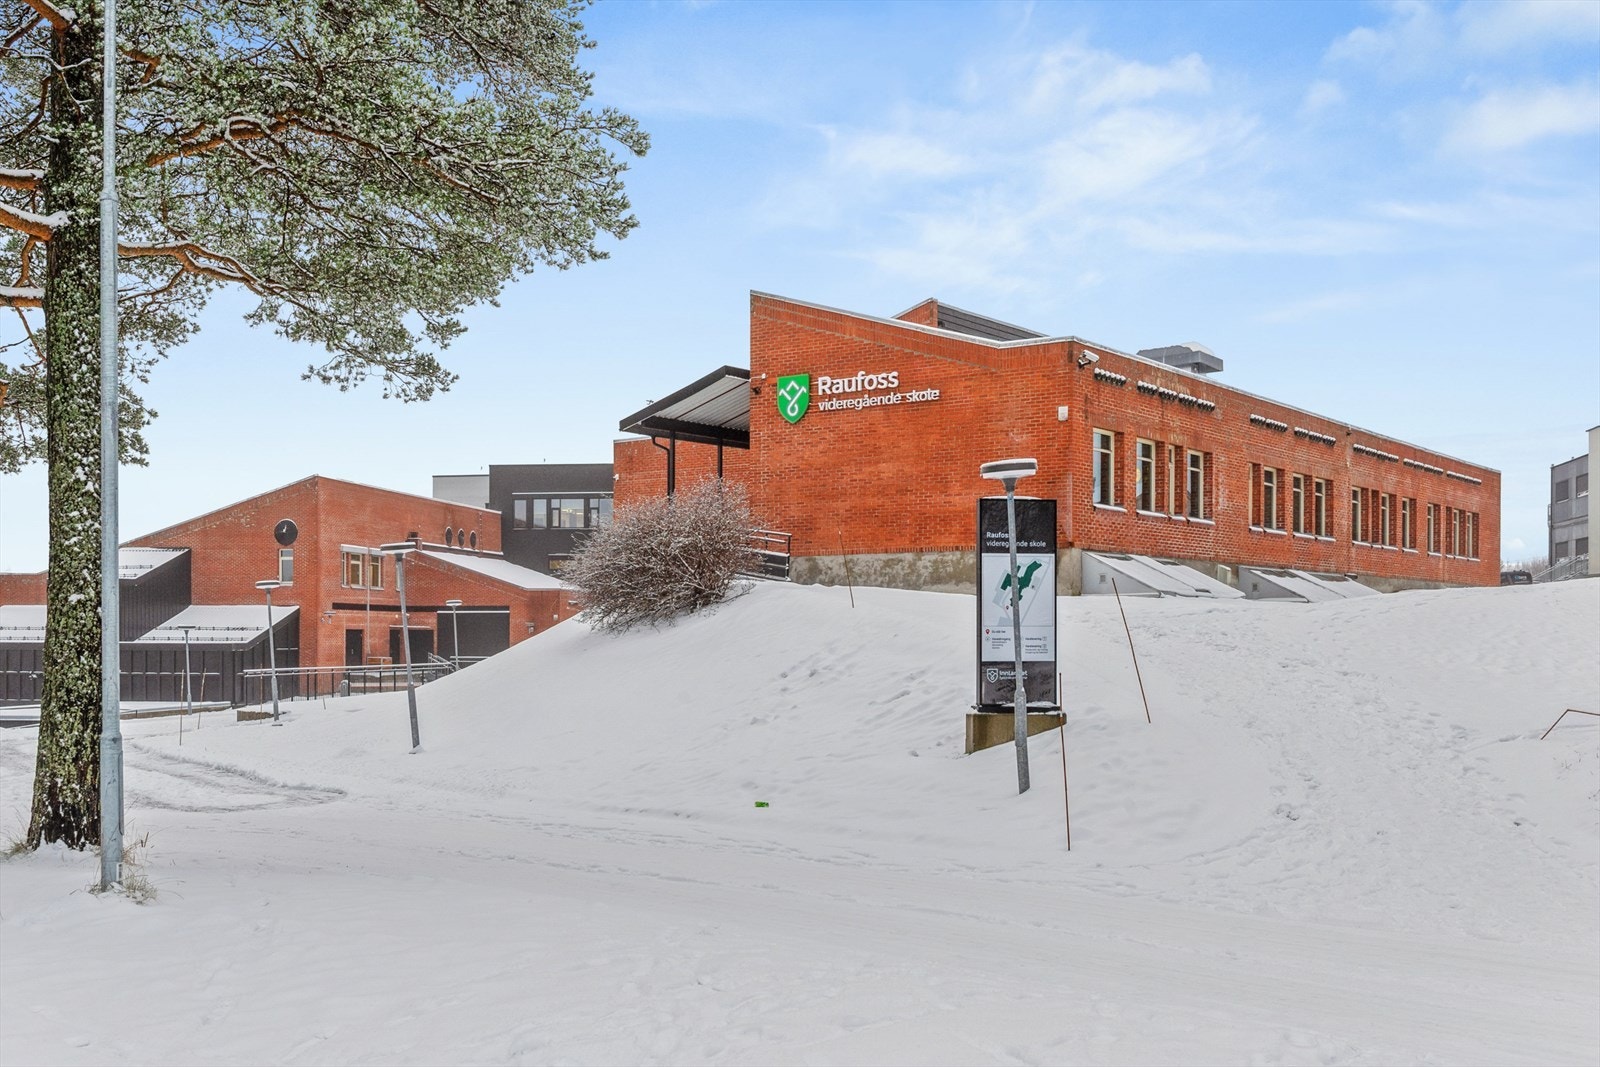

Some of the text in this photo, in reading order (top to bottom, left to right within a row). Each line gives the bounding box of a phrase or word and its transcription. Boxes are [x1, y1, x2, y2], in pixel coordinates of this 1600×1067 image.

[817, 371, 899, 395] Raufoss
[818, 388, 940, 411] videregående skole
